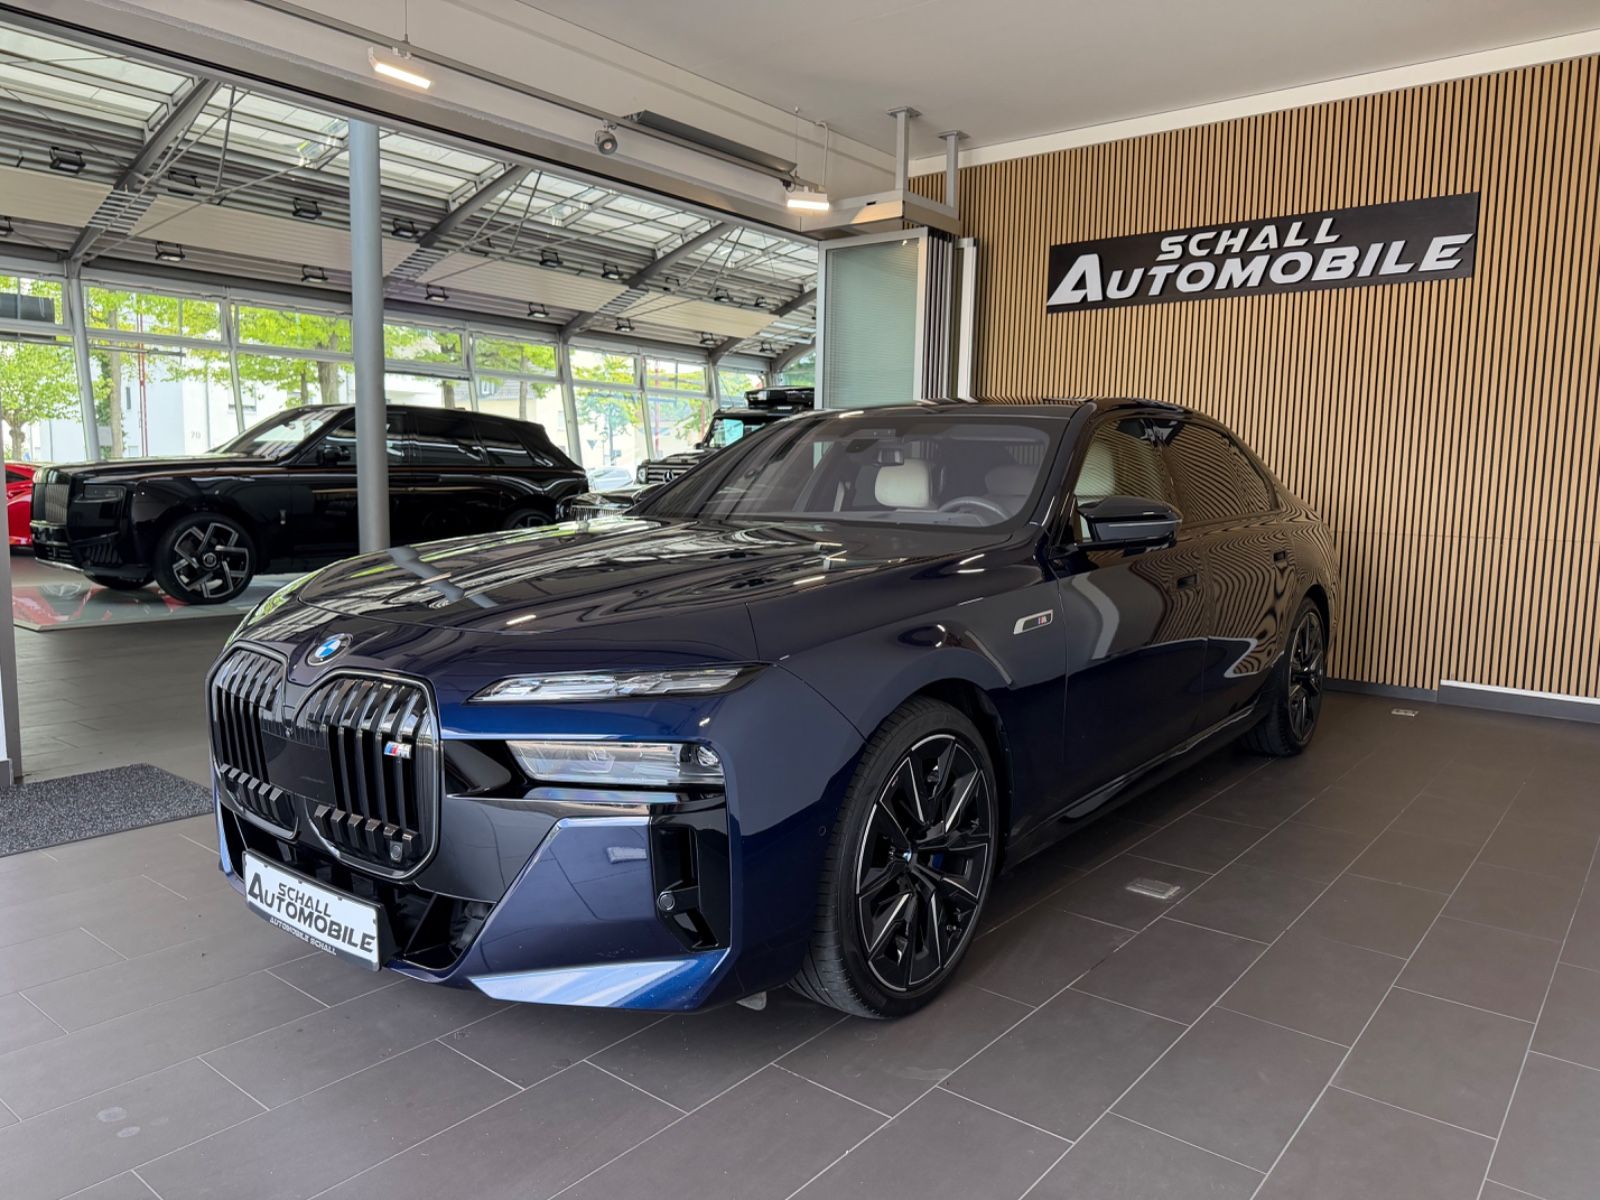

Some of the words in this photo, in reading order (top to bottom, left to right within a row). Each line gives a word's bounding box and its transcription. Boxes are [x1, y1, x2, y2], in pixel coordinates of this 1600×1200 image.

[1156, 217, 1341, 262] SCHALL
[1046, 233, 1473, 307] AUTOMOBILE
[248, 871, 376, 953] AUTOMOBILE
[278, 882, 332, 918] SCHALL
[269, 916, 309, 943] AUTOMOBILE
[310, 937, 337, 956] SCHALL
